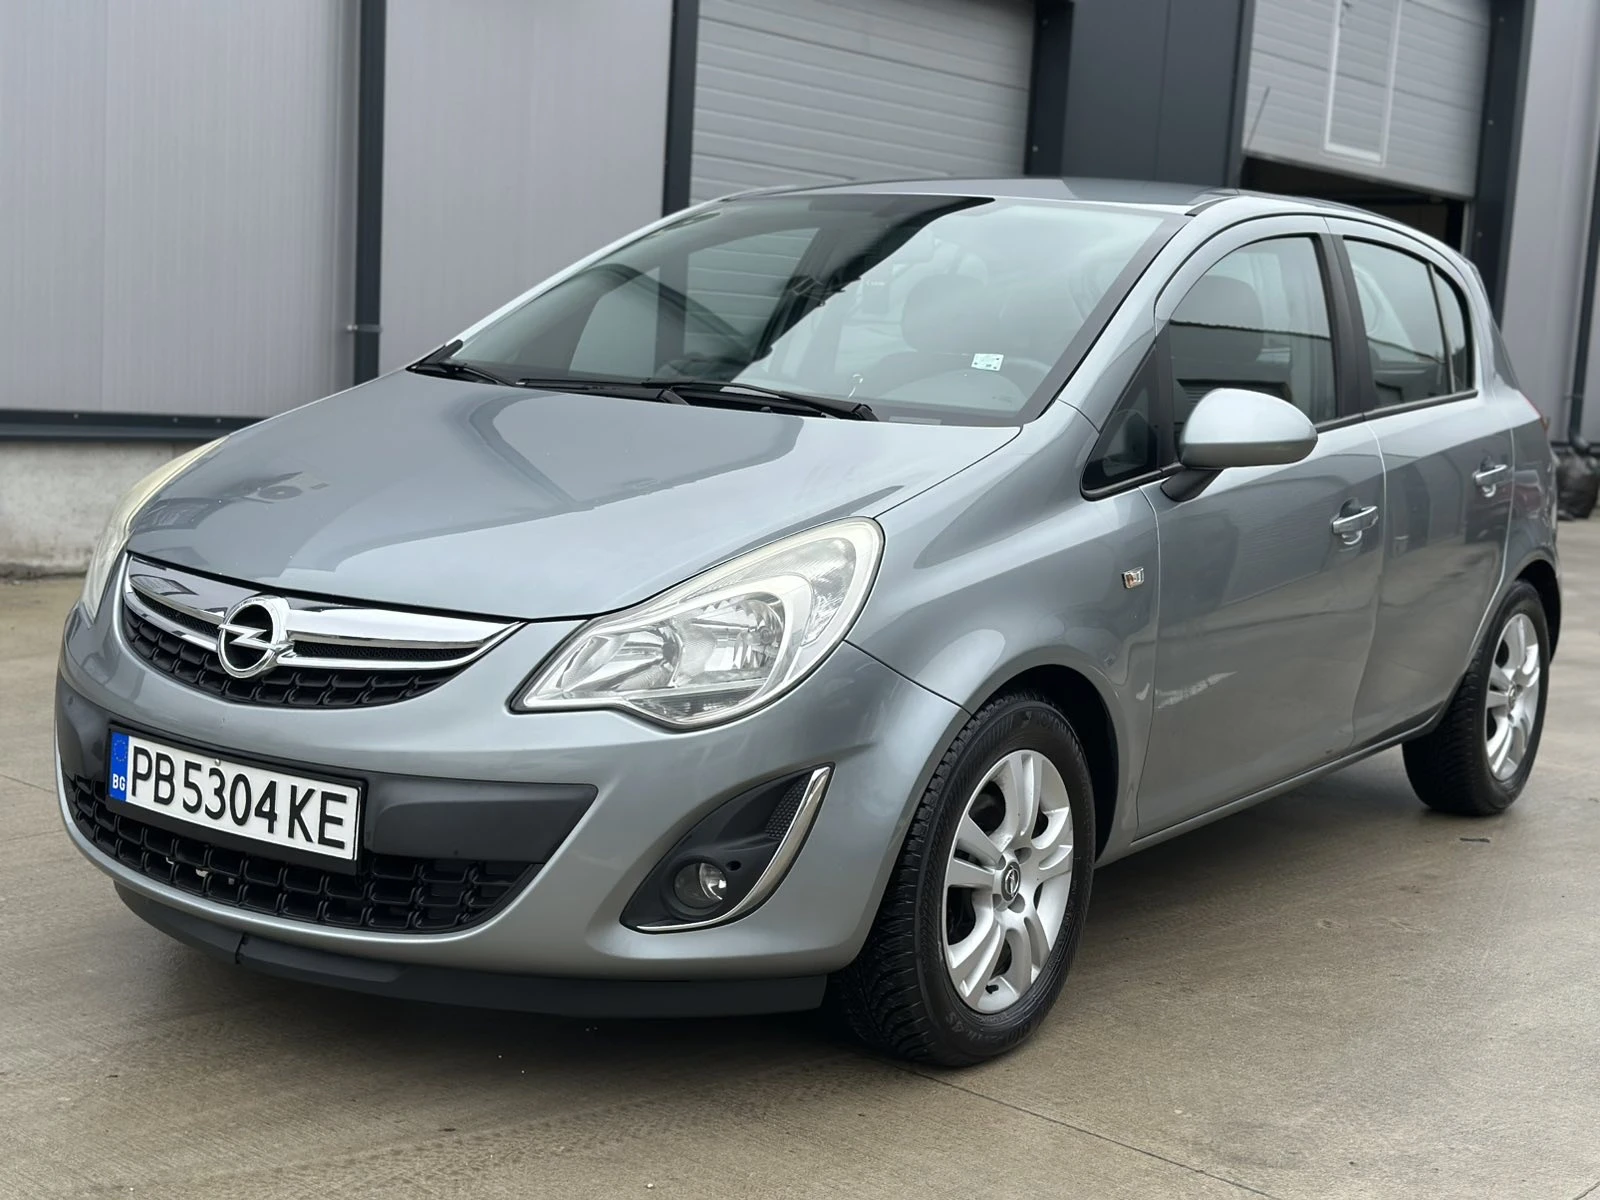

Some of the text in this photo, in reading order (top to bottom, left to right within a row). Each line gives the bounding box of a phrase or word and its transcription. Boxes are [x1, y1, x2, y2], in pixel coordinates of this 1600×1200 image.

[112, 773, 126, 791] BG
[131, 746, 348, 850] PB 5304 KE
